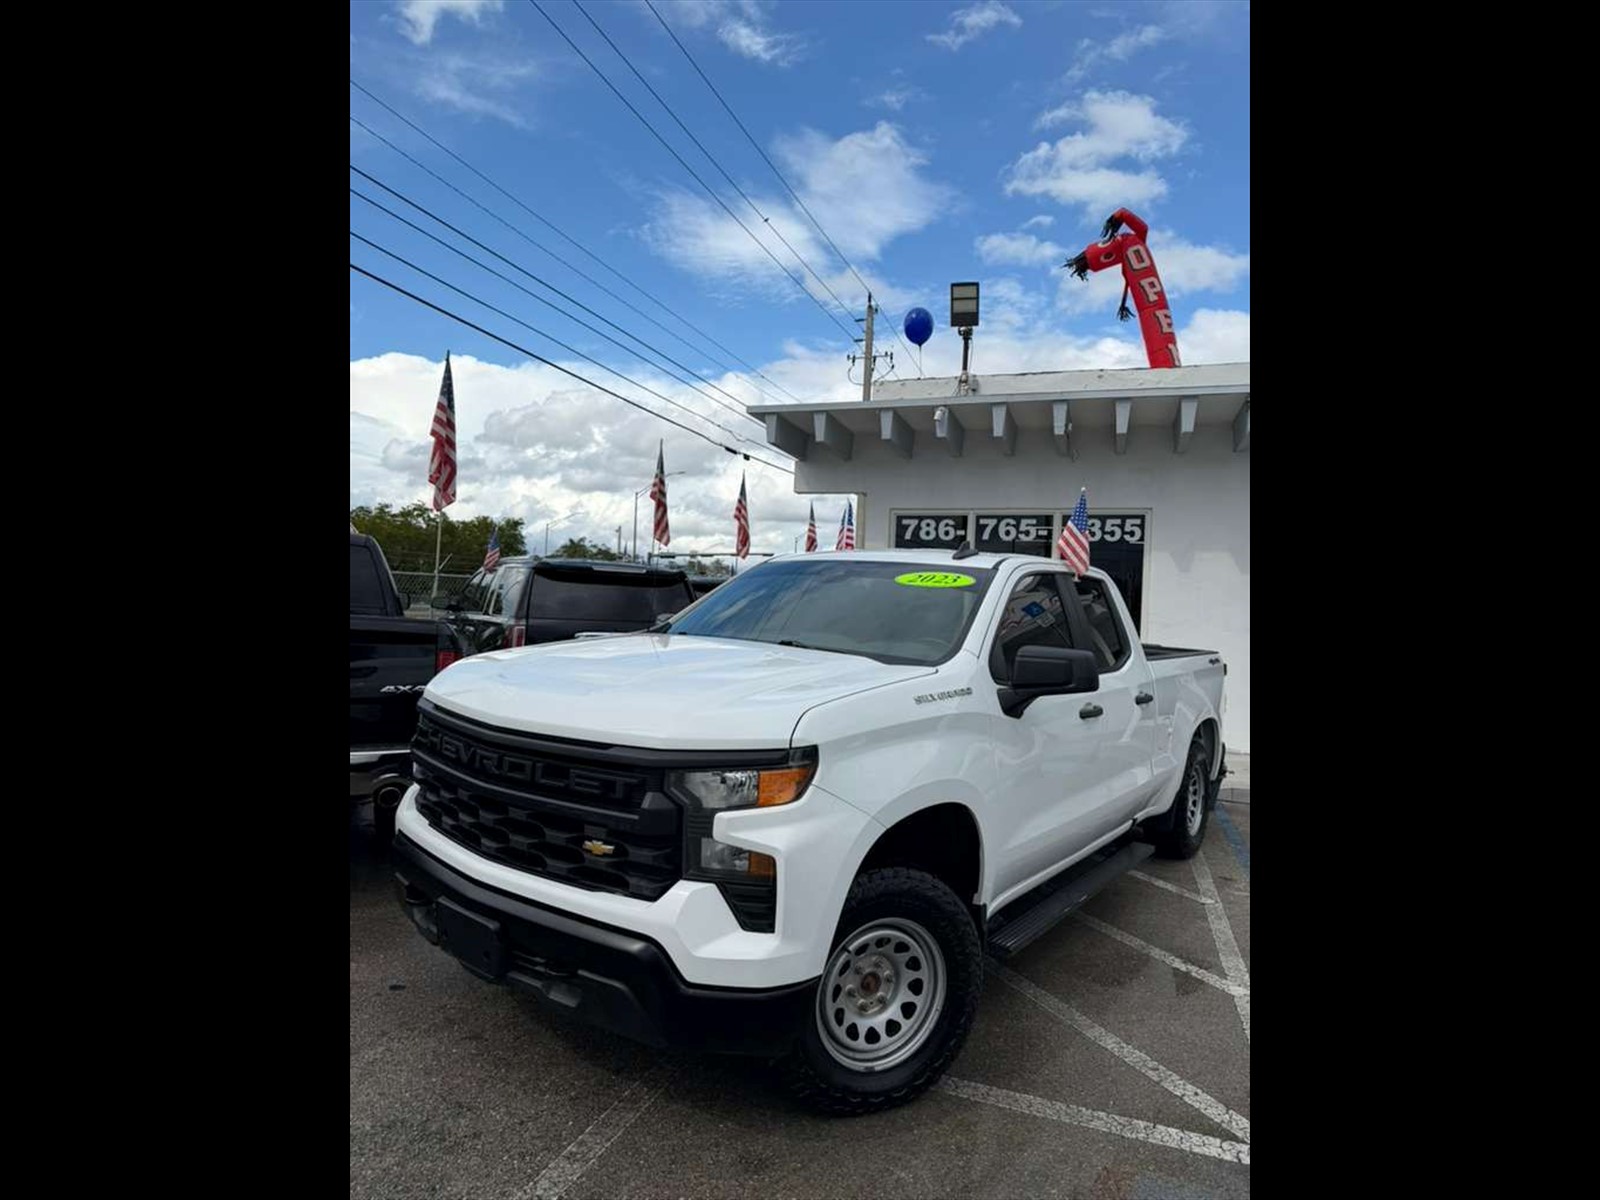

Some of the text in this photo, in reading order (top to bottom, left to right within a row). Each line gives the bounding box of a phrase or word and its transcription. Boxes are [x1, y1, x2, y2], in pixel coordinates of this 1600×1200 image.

[901, 518, 965, 541] 786-
[978, 517, 1048, 541] 765-
[907, 573, 961, 585] 2023
